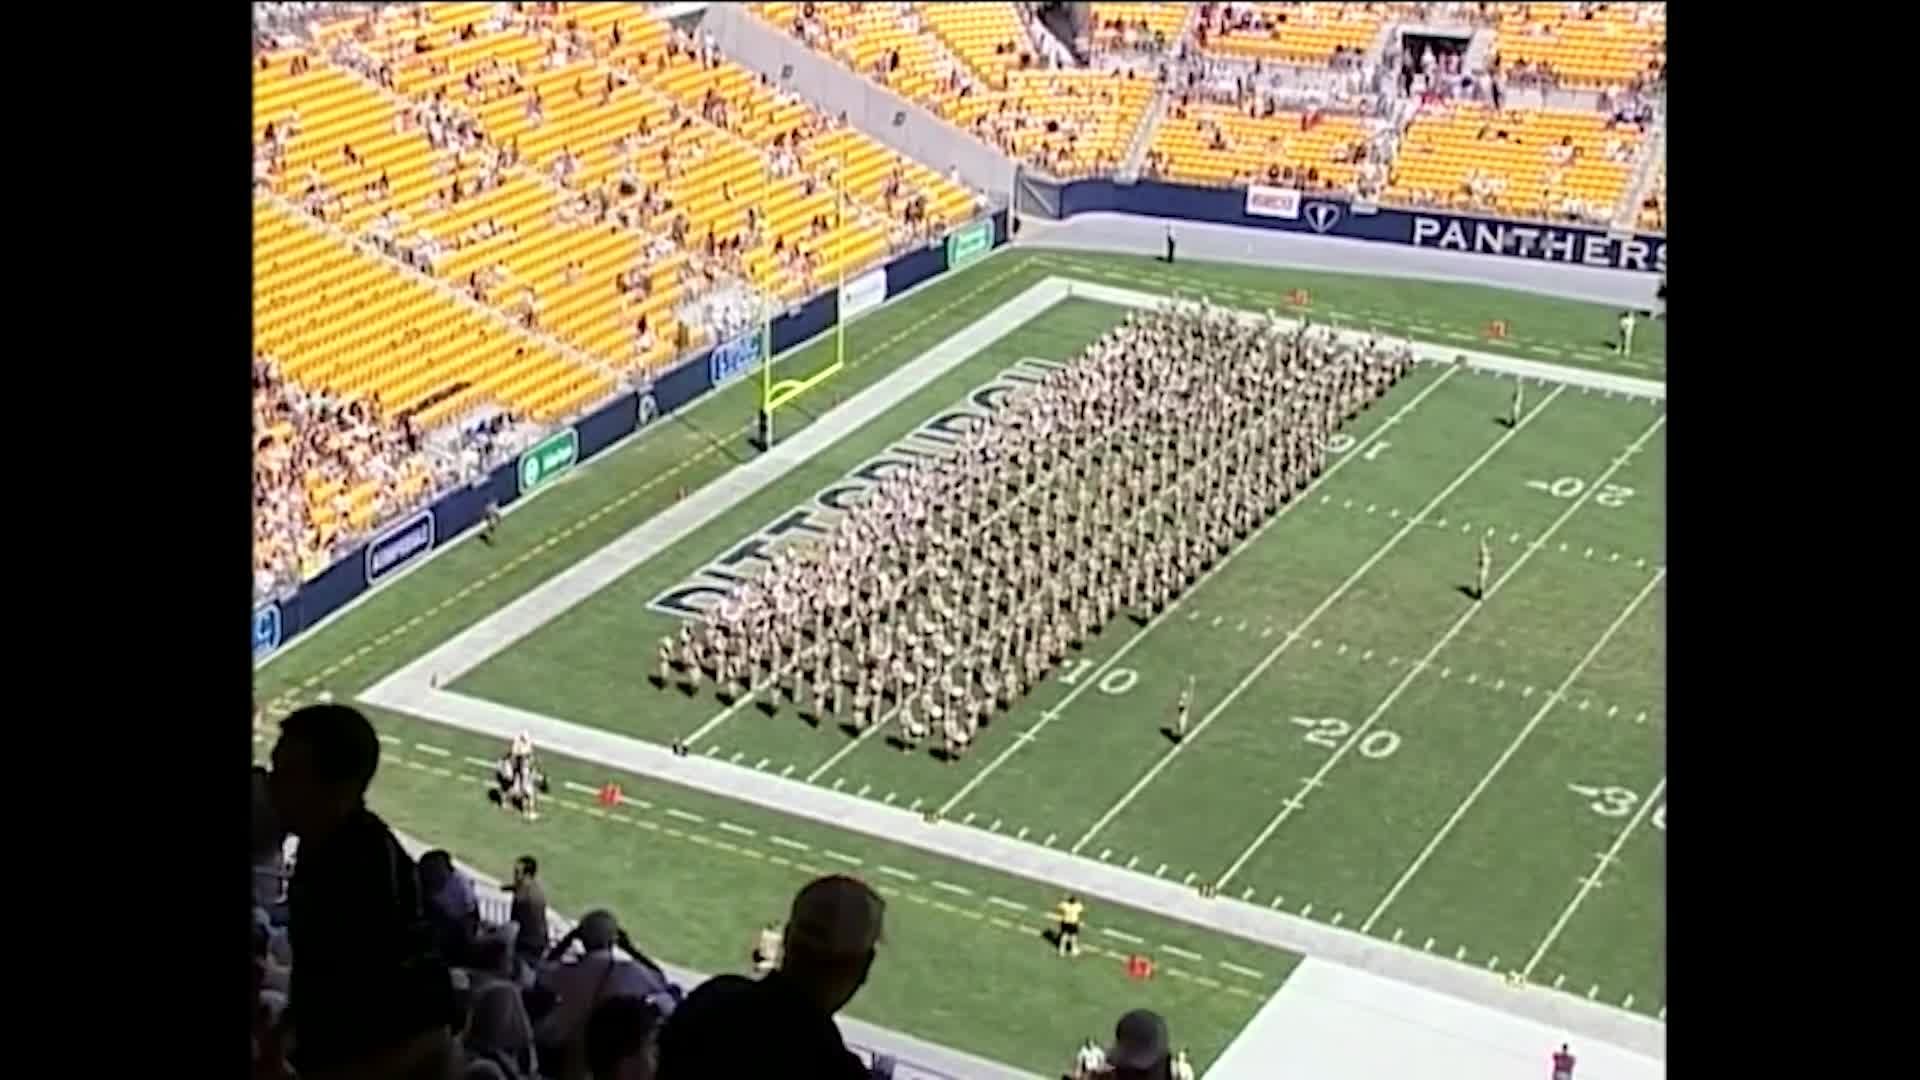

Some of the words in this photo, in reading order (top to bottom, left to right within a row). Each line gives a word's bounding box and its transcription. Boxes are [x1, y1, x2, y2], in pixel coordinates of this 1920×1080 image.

[1550, 476, 1635, 507] 20
[1057, 658, 1139, 695] 10
[1300, 717, 1401, 759] 20
